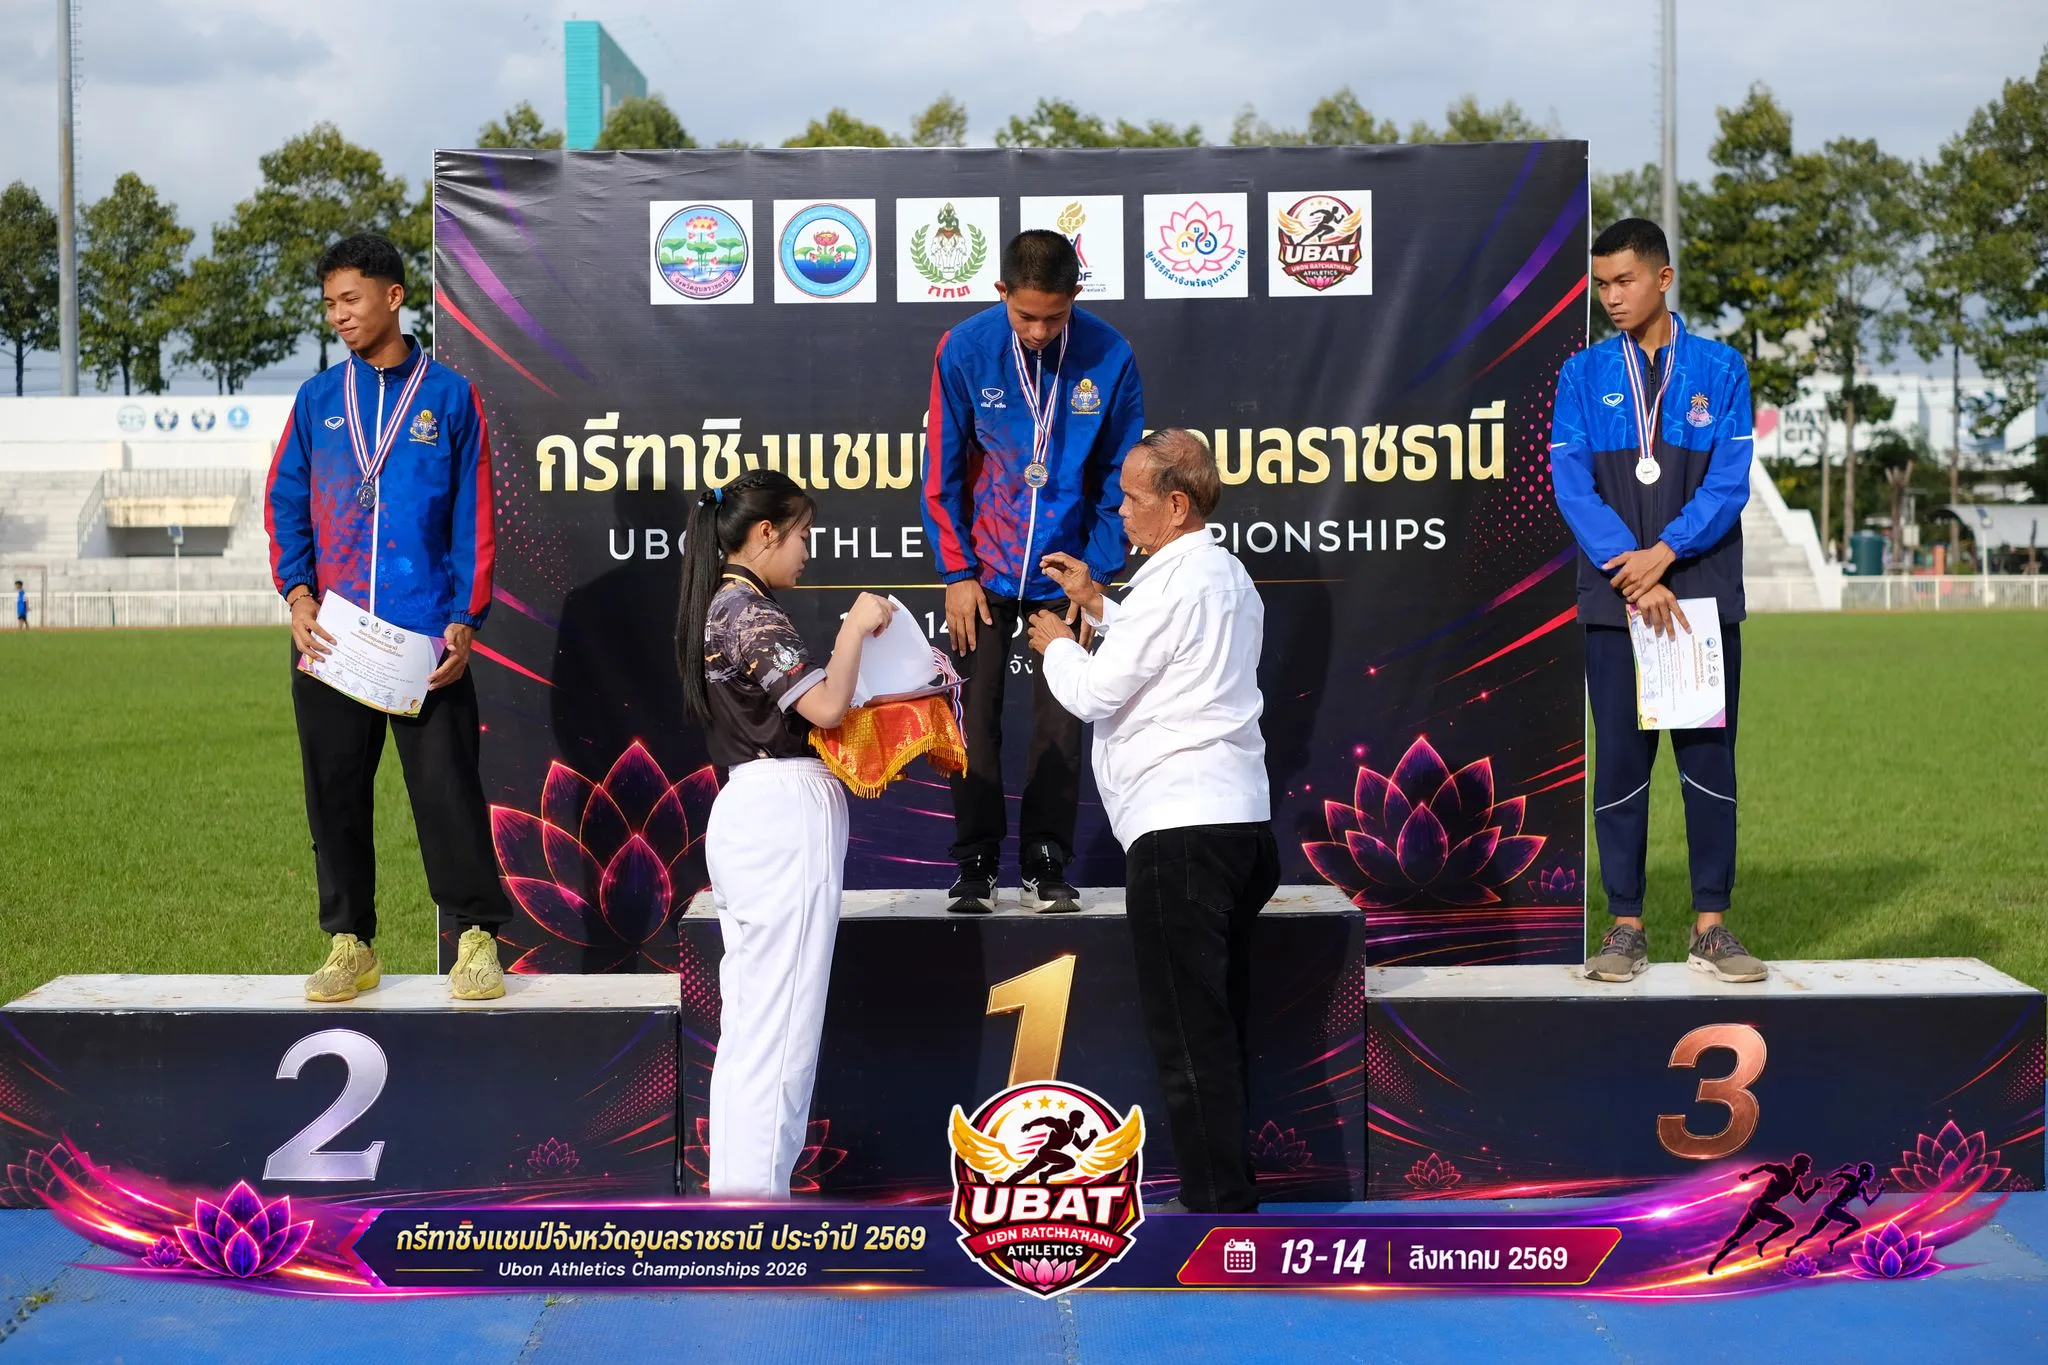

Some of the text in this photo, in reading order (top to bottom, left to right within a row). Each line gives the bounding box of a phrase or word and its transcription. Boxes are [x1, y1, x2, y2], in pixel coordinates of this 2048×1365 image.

[927, 285, 971, 299] กกท
[1284, 243, 1356, 264] UBAT
[536, 400, 1506, 492] กรีฑาชิงแชม บลราชธานี
[609, 528, 687, 560] UB
[1130, 517, 1446, 555] PIONSHIPS
[986, 954, 1077, 1088] 1
[262, 1028, 388, 1181] 2
[1656, 1023, 1768, 1160] 3
